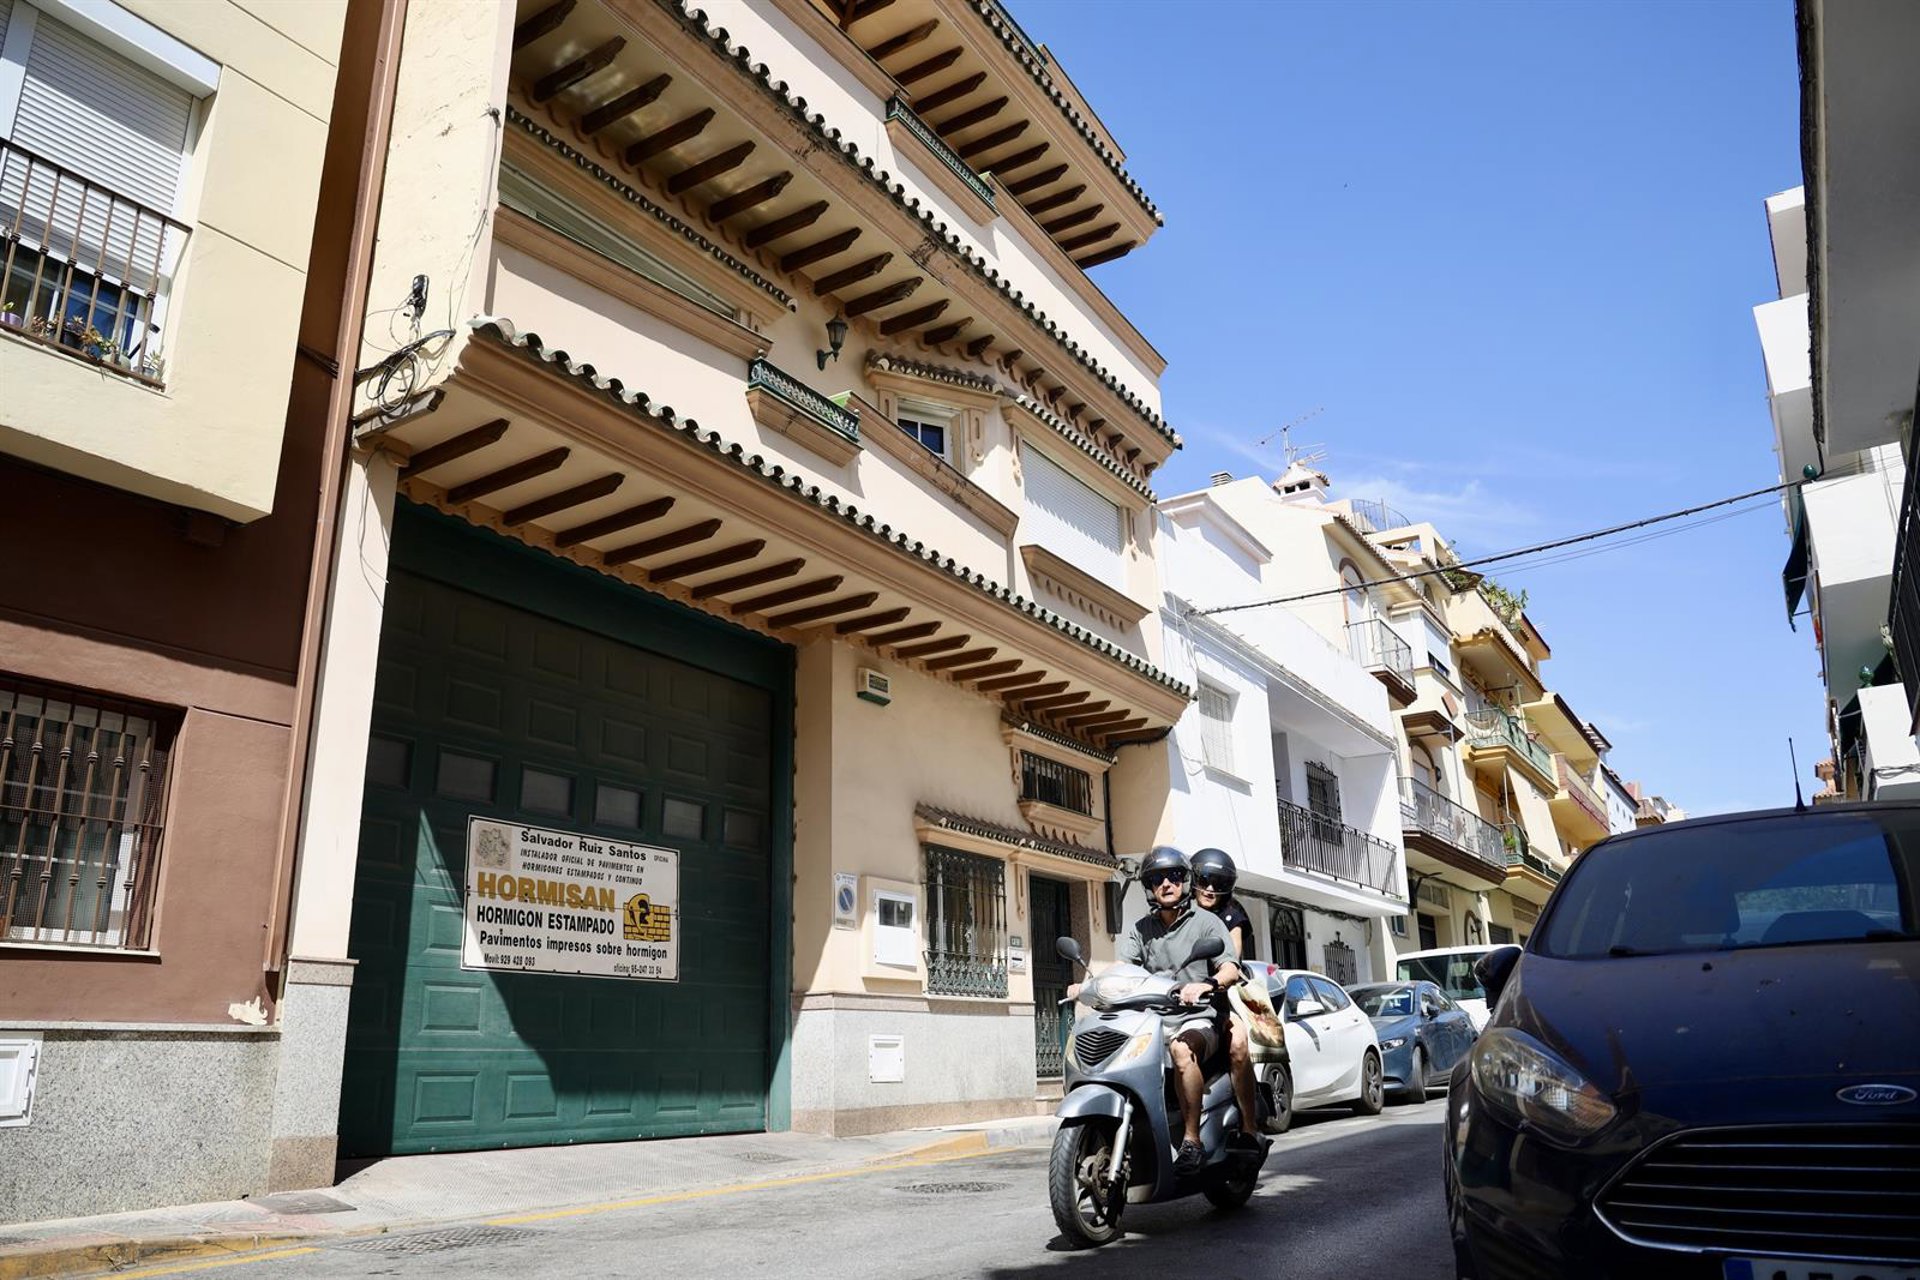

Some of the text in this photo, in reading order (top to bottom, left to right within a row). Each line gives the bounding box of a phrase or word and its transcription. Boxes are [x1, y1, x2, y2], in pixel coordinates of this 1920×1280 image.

[520, 848, 644, 874] INSTALADOR OFICIAL DE PAVIMENTOS EN
[521, 831, 647, 861] Salvador Ruiz Santos
[522, 862, 643, 885] HORMIGONES ESTAMPADOS Y CONTINUO
[477, 871, 616, 913] HORMISAN
[477, 905, 615, 935] HORMIGON ESTAMPADO
[480, 930, 668, 961] Pavimentos impresos sobre hormigon
[1854, 1089, 1898, 1100] Ford
